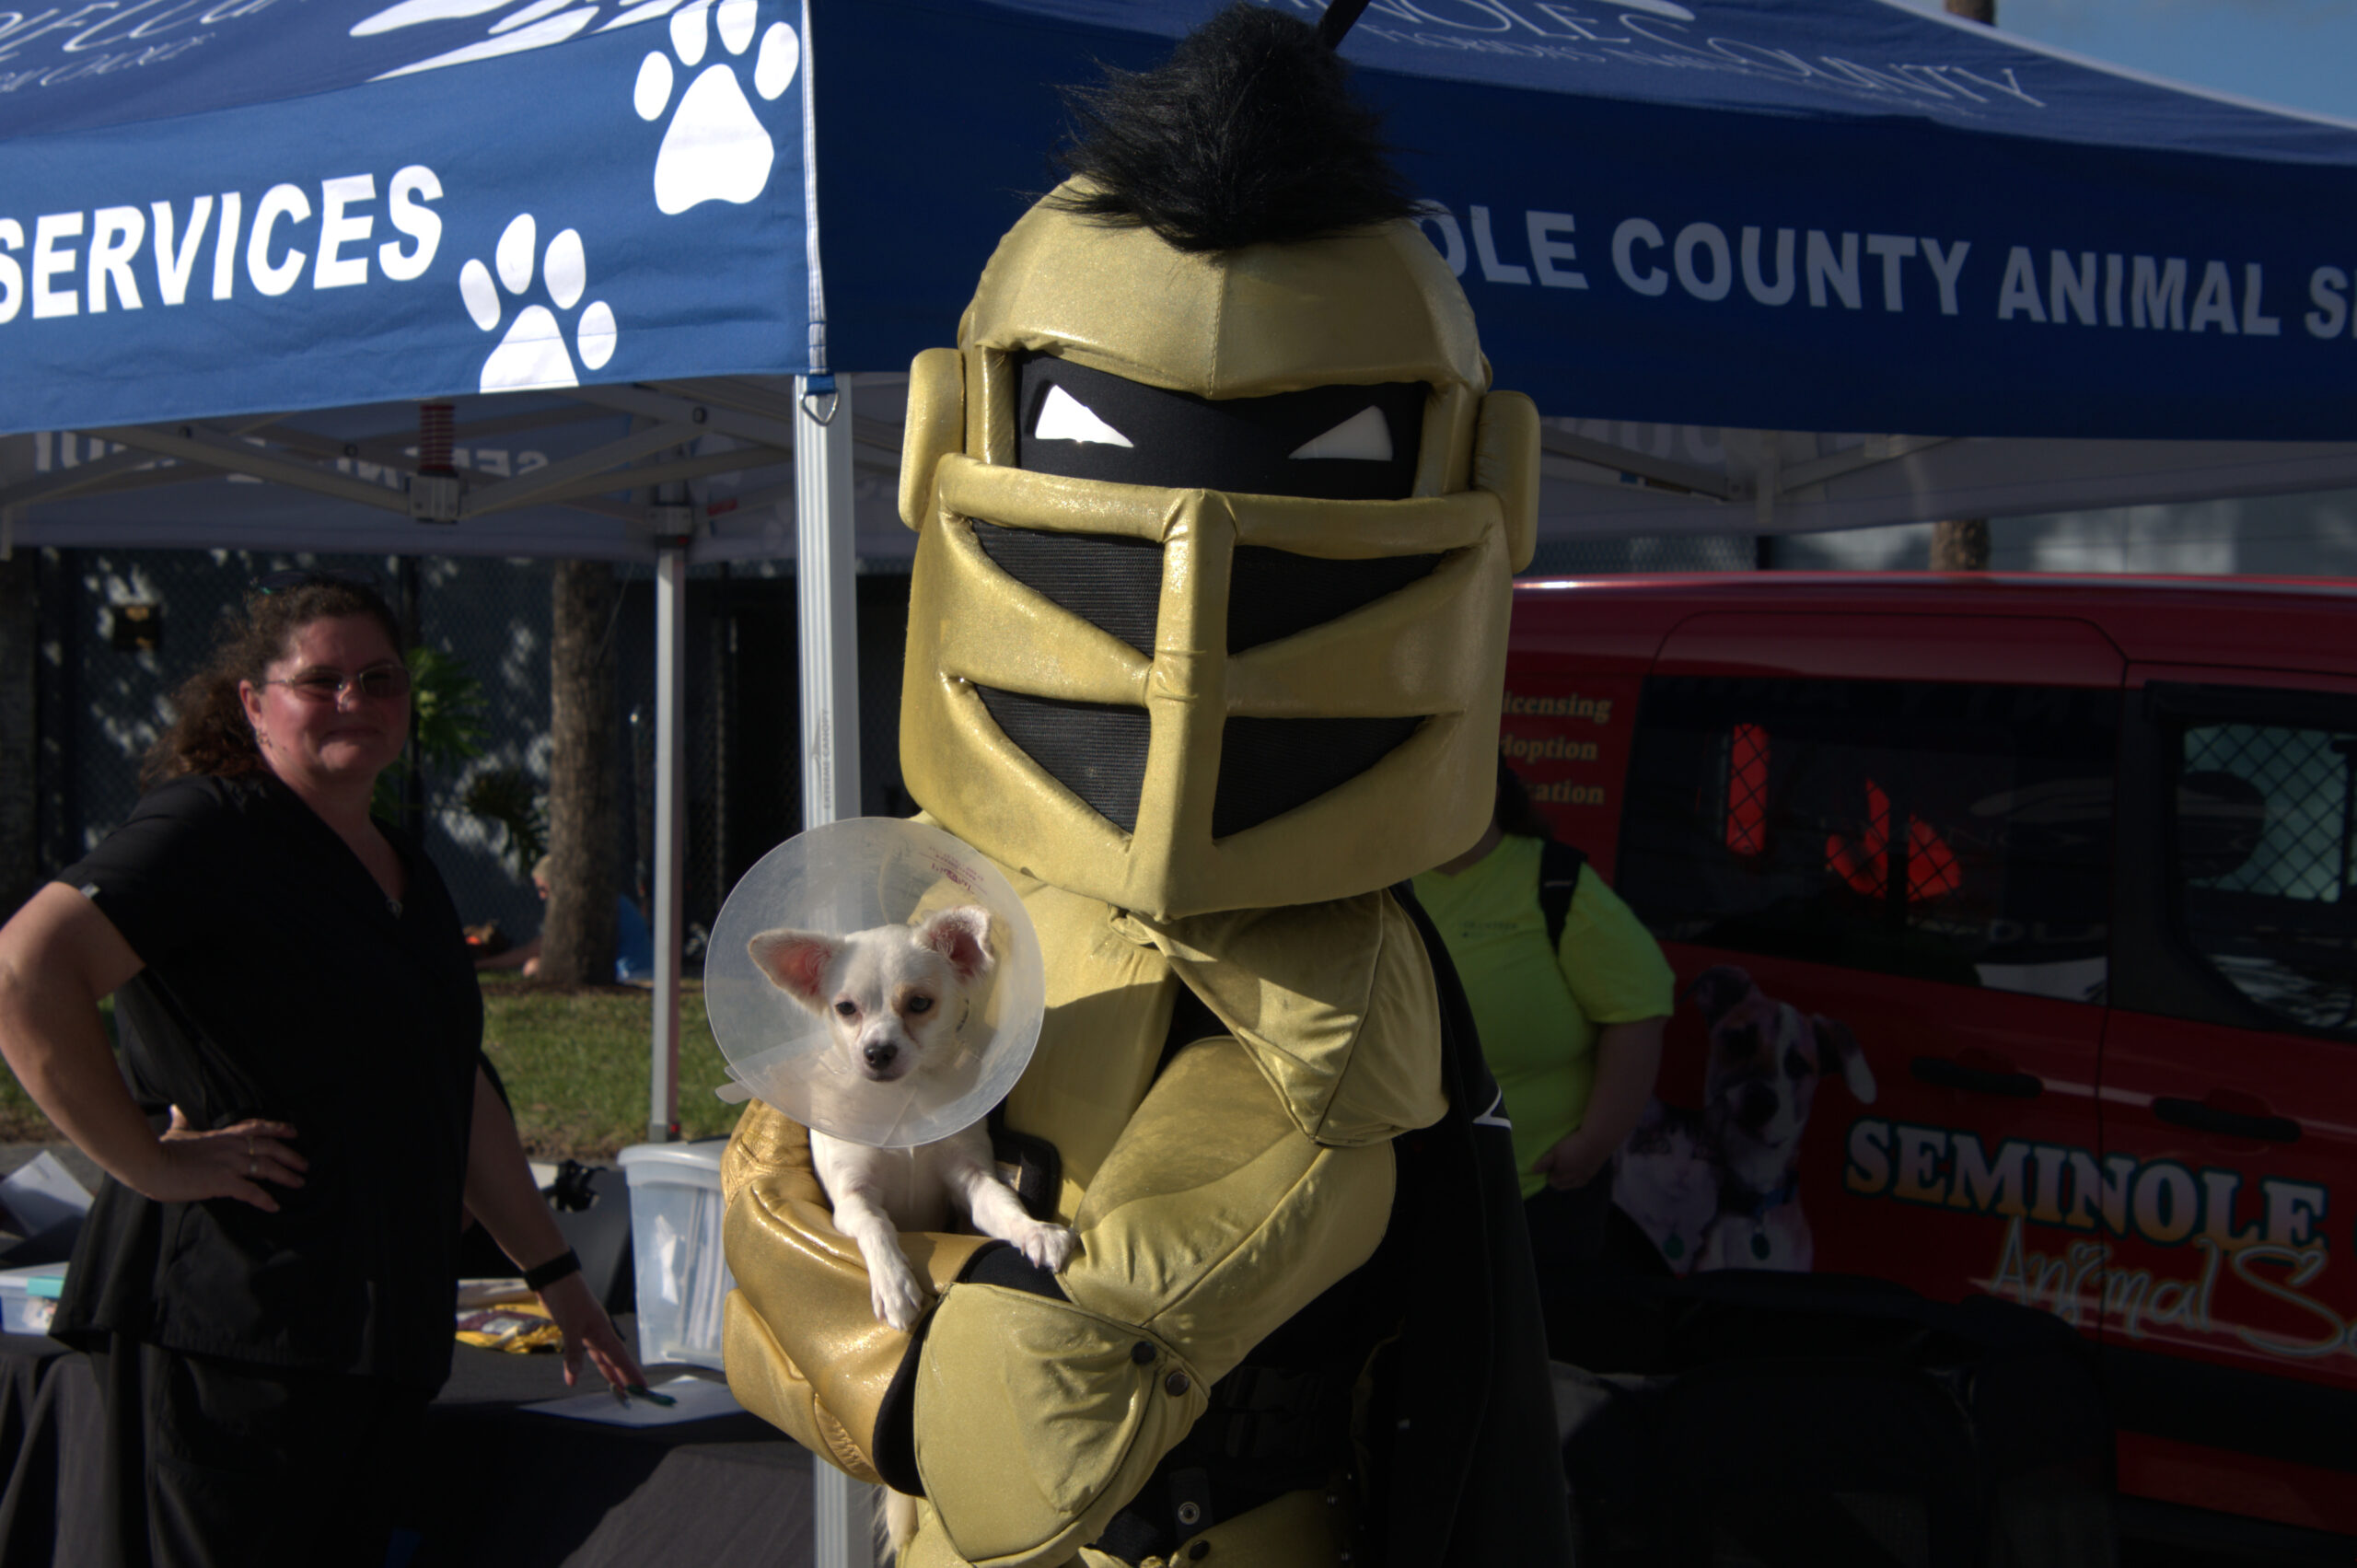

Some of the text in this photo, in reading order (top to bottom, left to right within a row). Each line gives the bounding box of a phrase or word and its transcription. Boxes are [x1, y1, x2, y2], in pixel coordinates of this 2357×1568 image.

[1618, 13, 2047, 107] COUNTY
[1410, 198, 2357, 339] OLE COUNTY ANIMAL S
[1502, 689, 1614, 725] icensing
[1502, 732, 1598, 765] doption
[1527, 777, 1605, 805] ation
[1844, 1116, 2329, 1267] SEMINOLE
[1989, 1214, 2221, 1340] Animal
